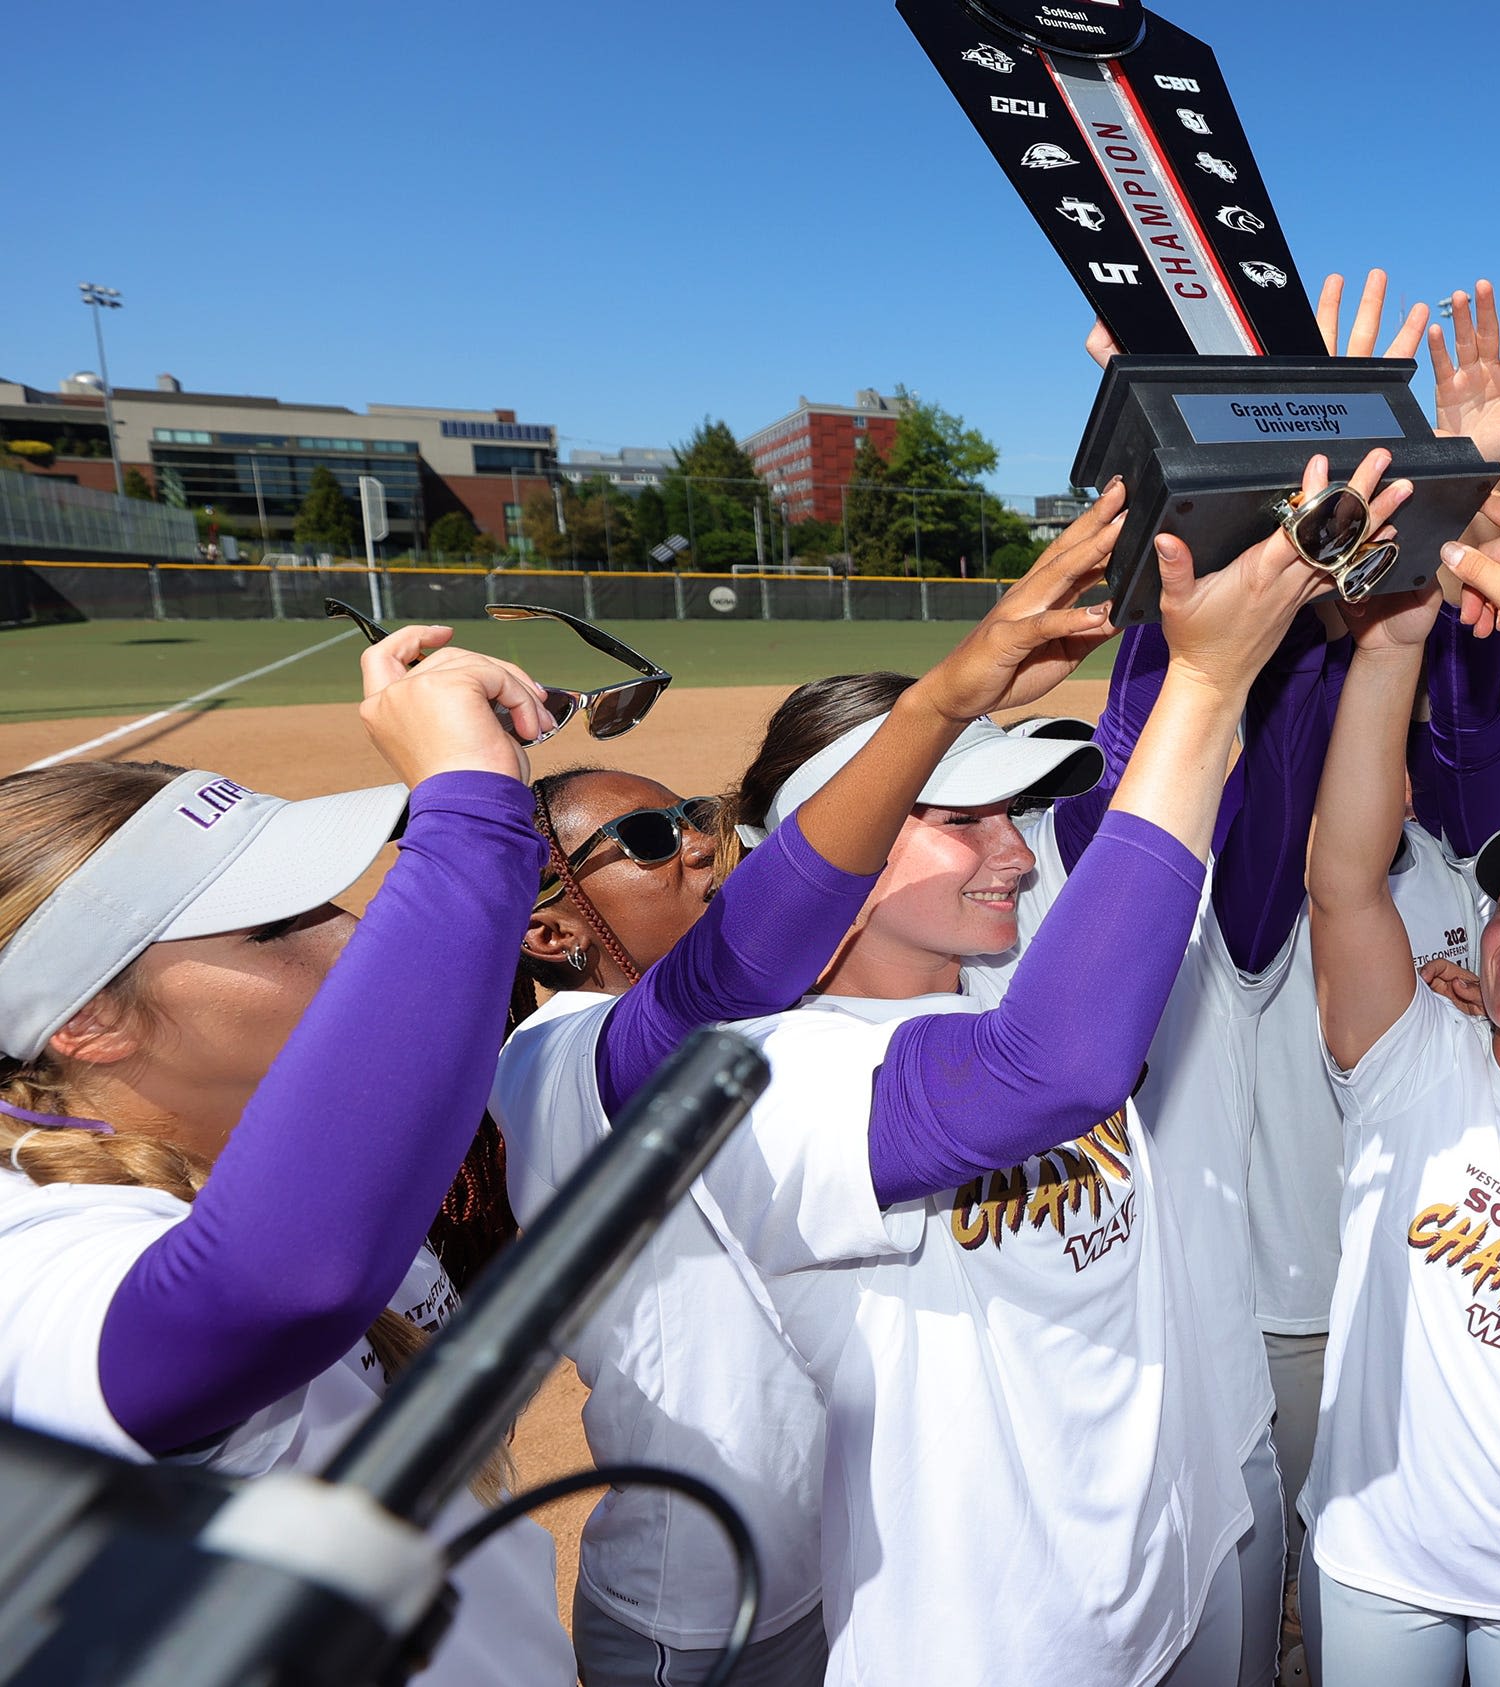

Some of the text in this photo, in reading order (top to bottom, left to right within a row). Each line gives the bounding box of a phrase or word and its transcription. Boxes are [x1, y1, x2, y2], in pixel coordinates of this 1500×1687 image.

[1041, 6, 1089, 22] Softball
[1035, 15, 1107, 35] Tournament
[1153, 74, 1200, 93] CBU
[990, 95, 1047, 118] GCU
[1091, 122, 1208, 299] CHAMPION
[1230, 402, 1348, 419] Grand Canyon
[1254, 417, 1341, 434] University
[1444, 927, 1468, 947] 202
